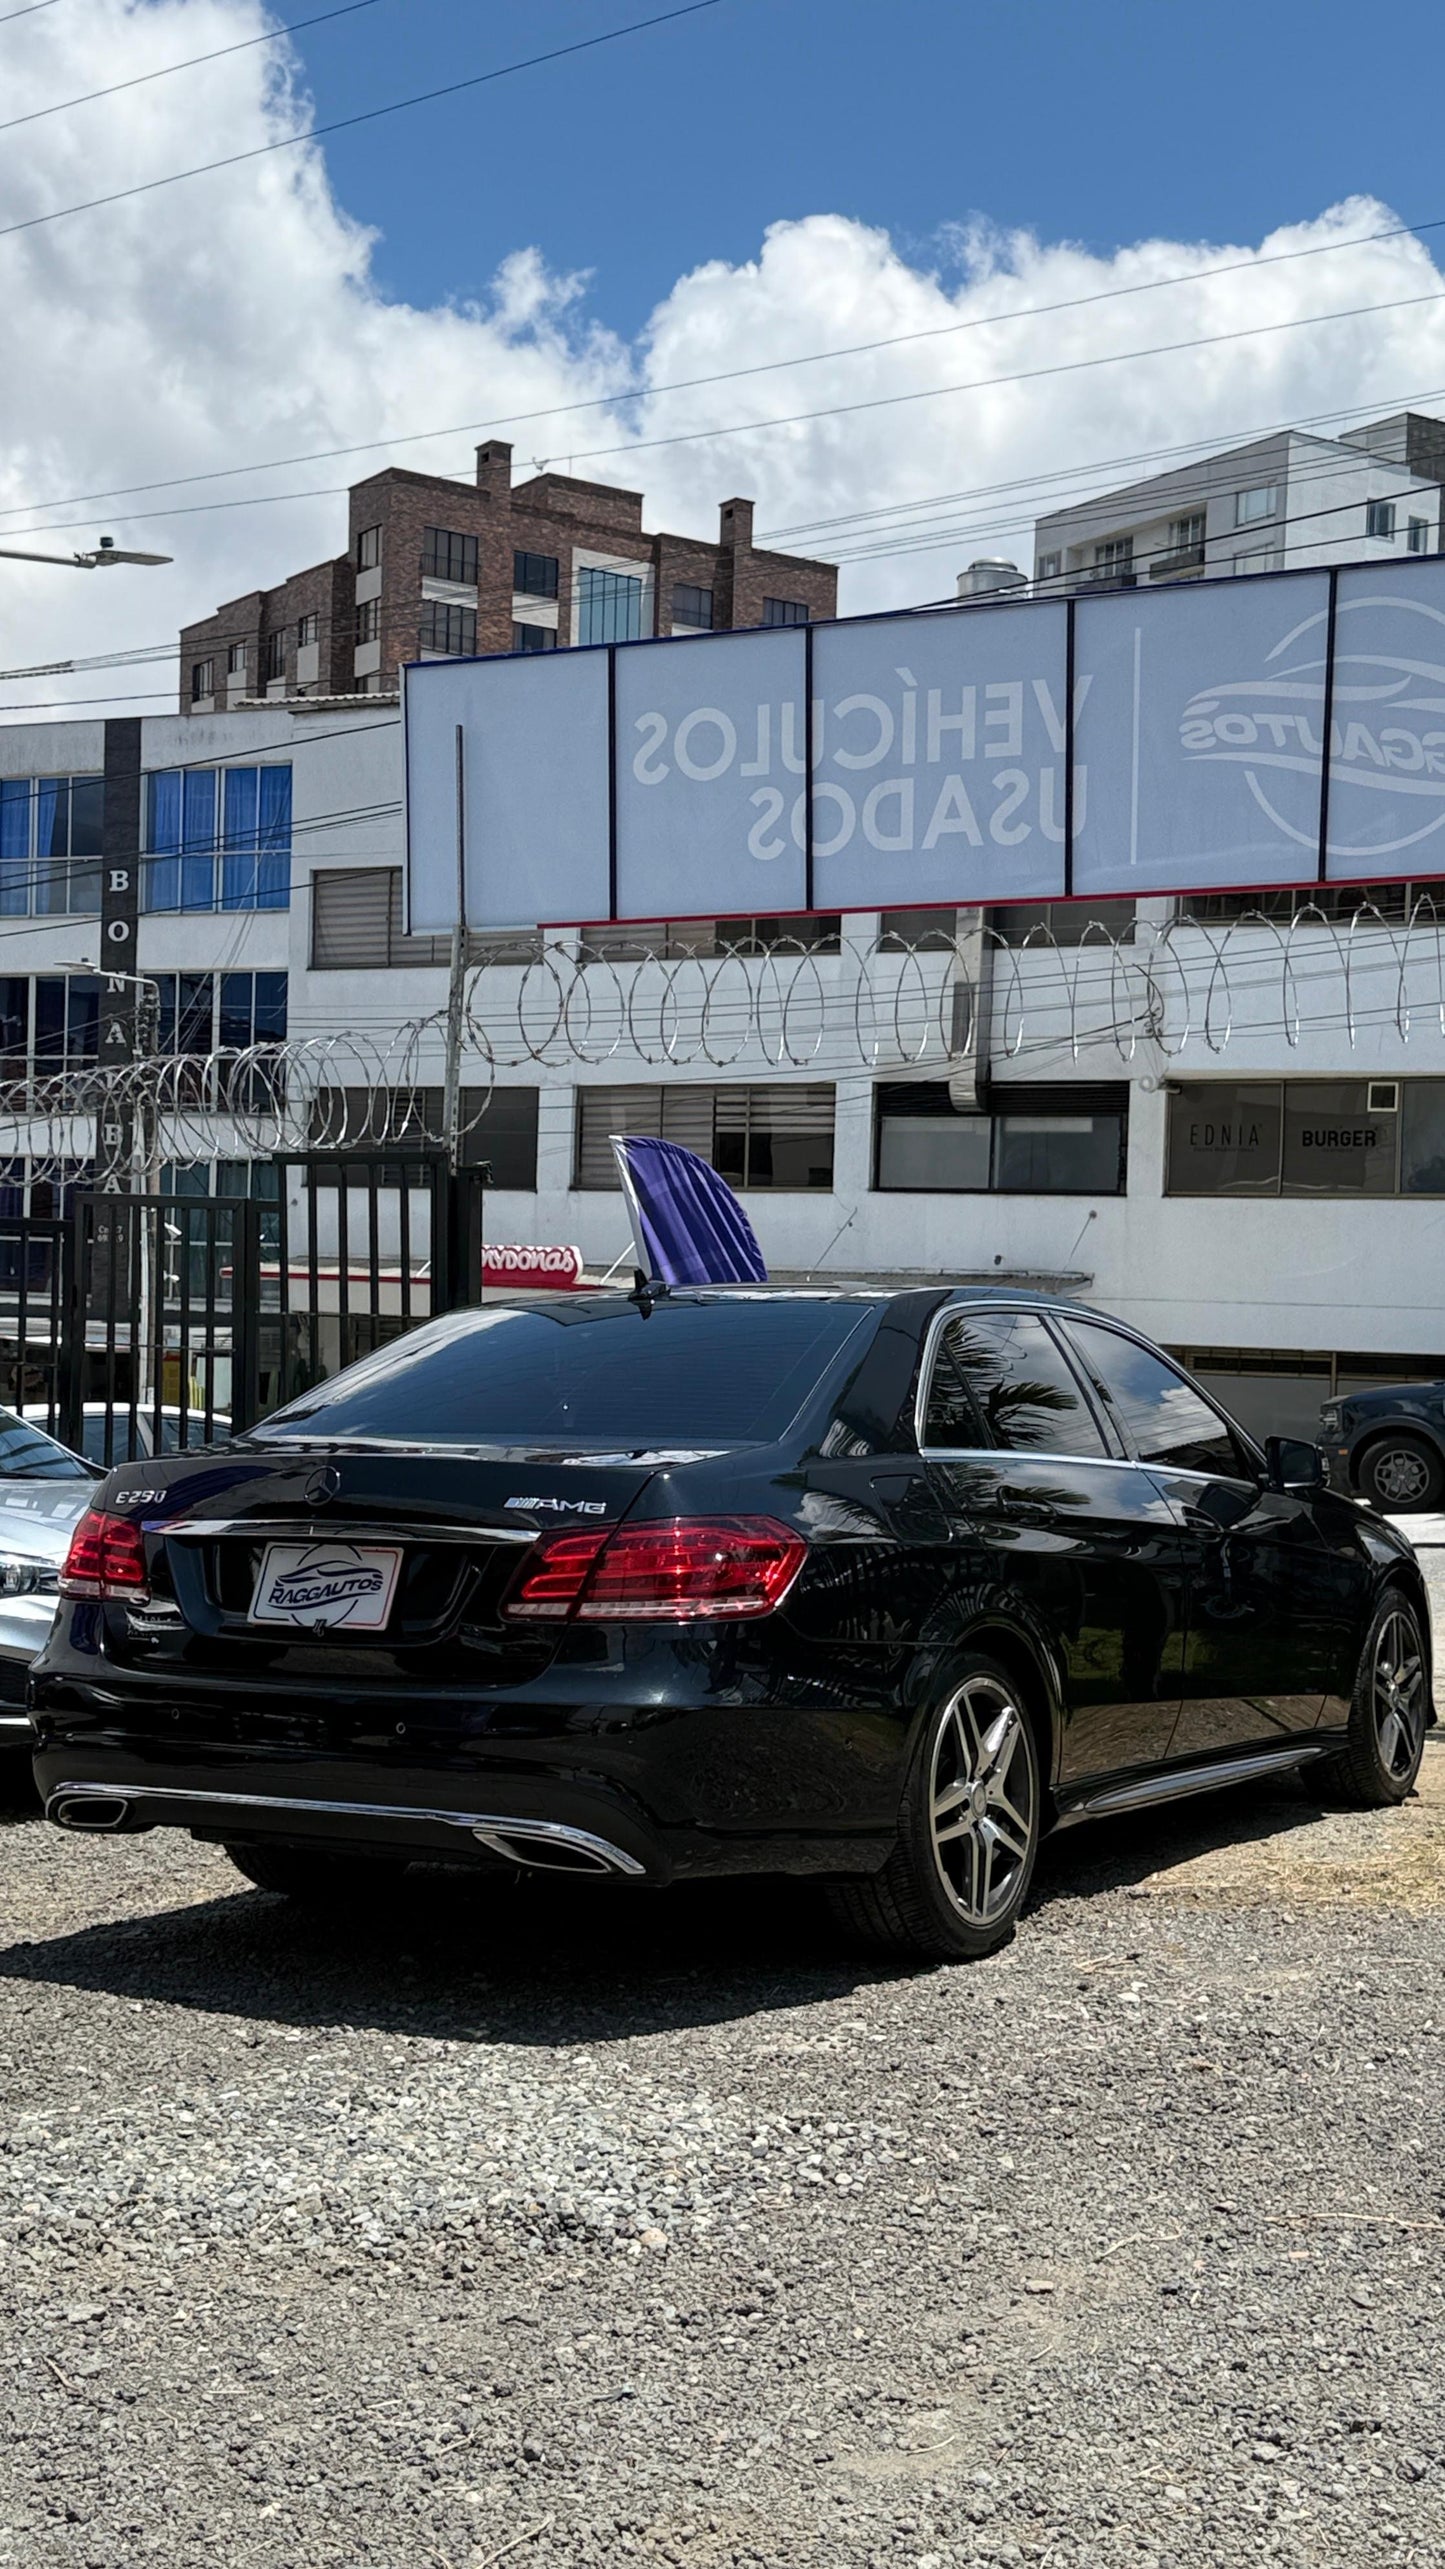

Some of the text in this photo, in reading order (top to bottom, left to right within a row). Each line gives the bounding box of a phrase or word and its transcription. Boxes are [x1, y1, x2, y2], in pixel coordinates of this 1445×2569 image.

[1190, 1123, 1259, 1146] EDNIA
[1302, 1129, 1377, 1148] BURGER
[115, 1489, 167, 1504] E250
[535, 1498, 606, 1515] AMG
[268, 1578, 384, 1605] RAGGAUTOS
